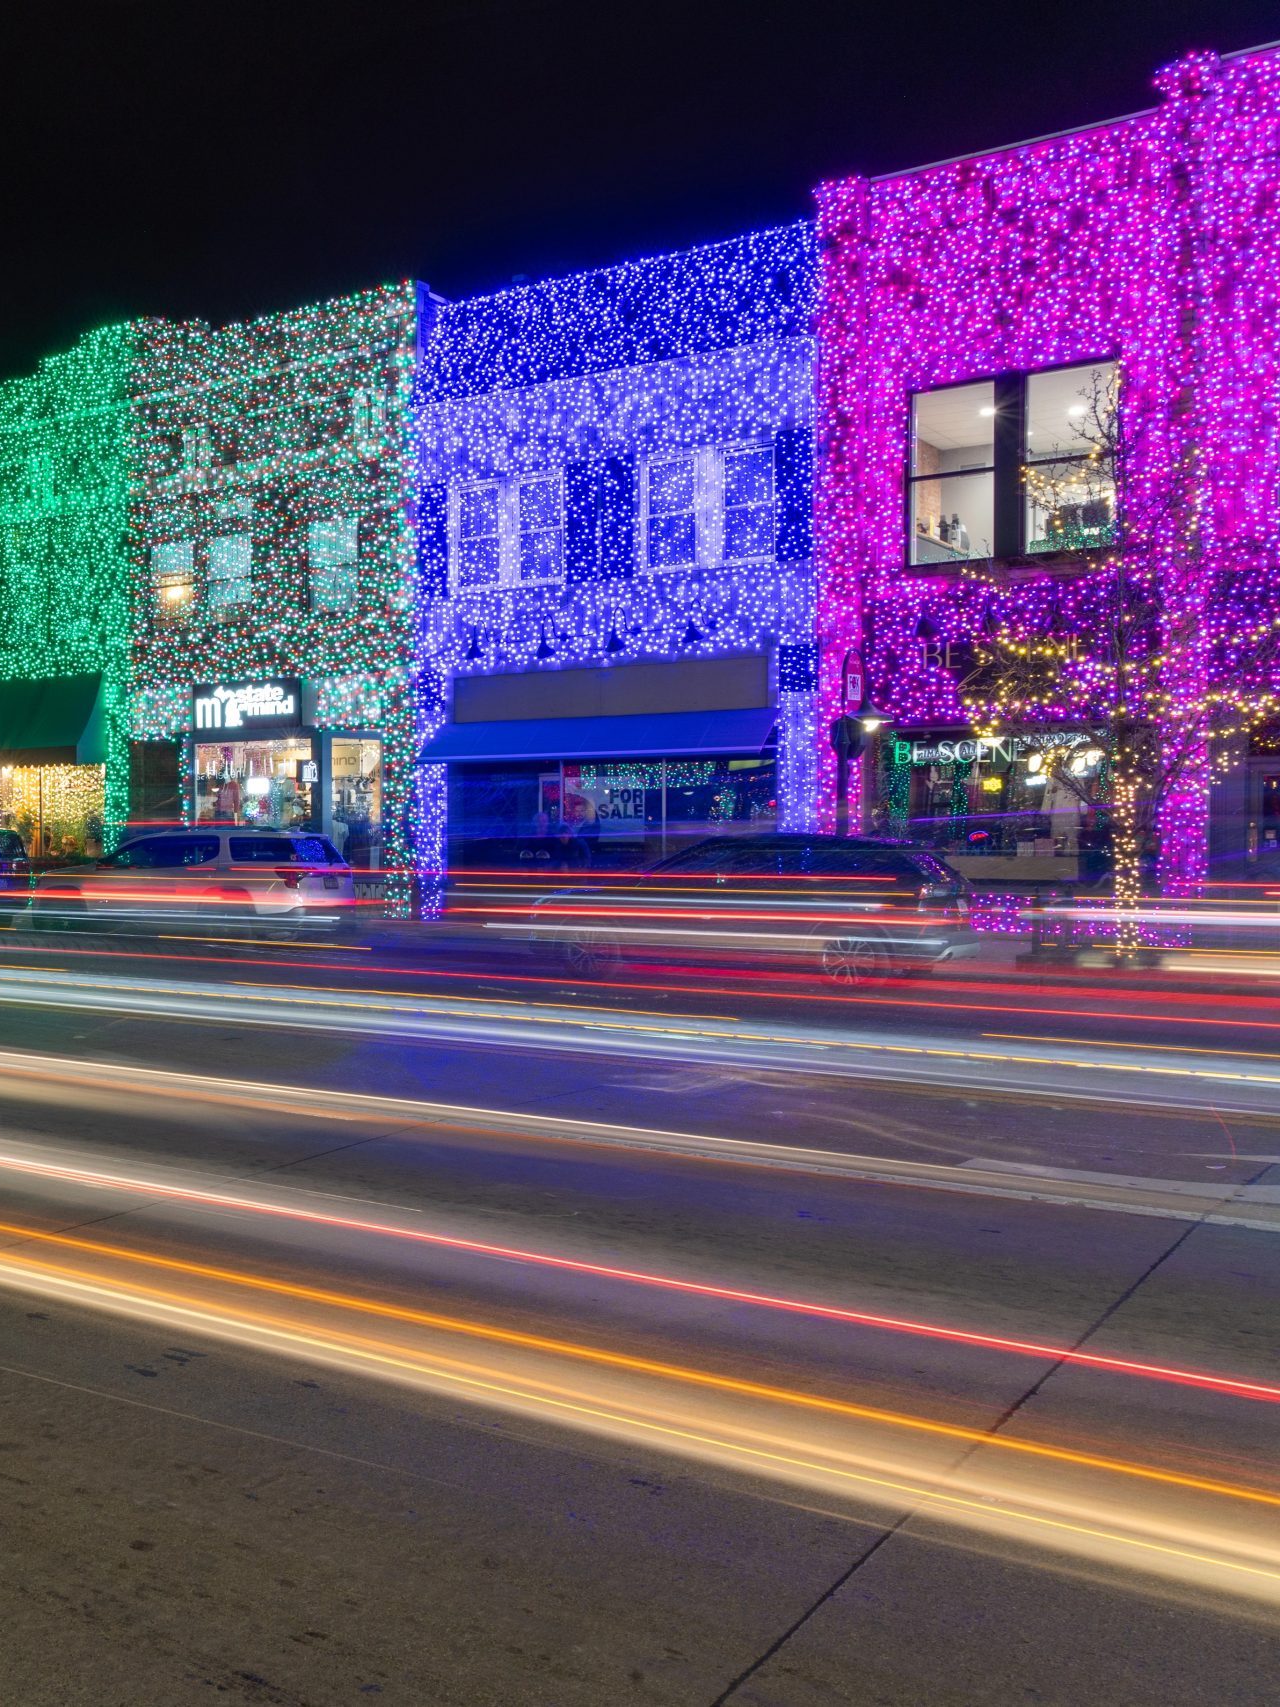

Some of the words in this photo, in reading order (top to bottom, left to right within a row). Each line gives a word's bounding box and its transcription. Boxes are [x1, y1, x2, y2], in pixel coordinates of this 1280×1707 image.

[922, 640, 962, 670] BE
[236, 683, 284, 702] state
[247, 695, 294, 716] mind
[894, 740, 928, 765] BE
[938, 736, 1028, 764] SCENE
[609, 788, 644, 804] FOR
[598, 803, 644, 820] SALE
